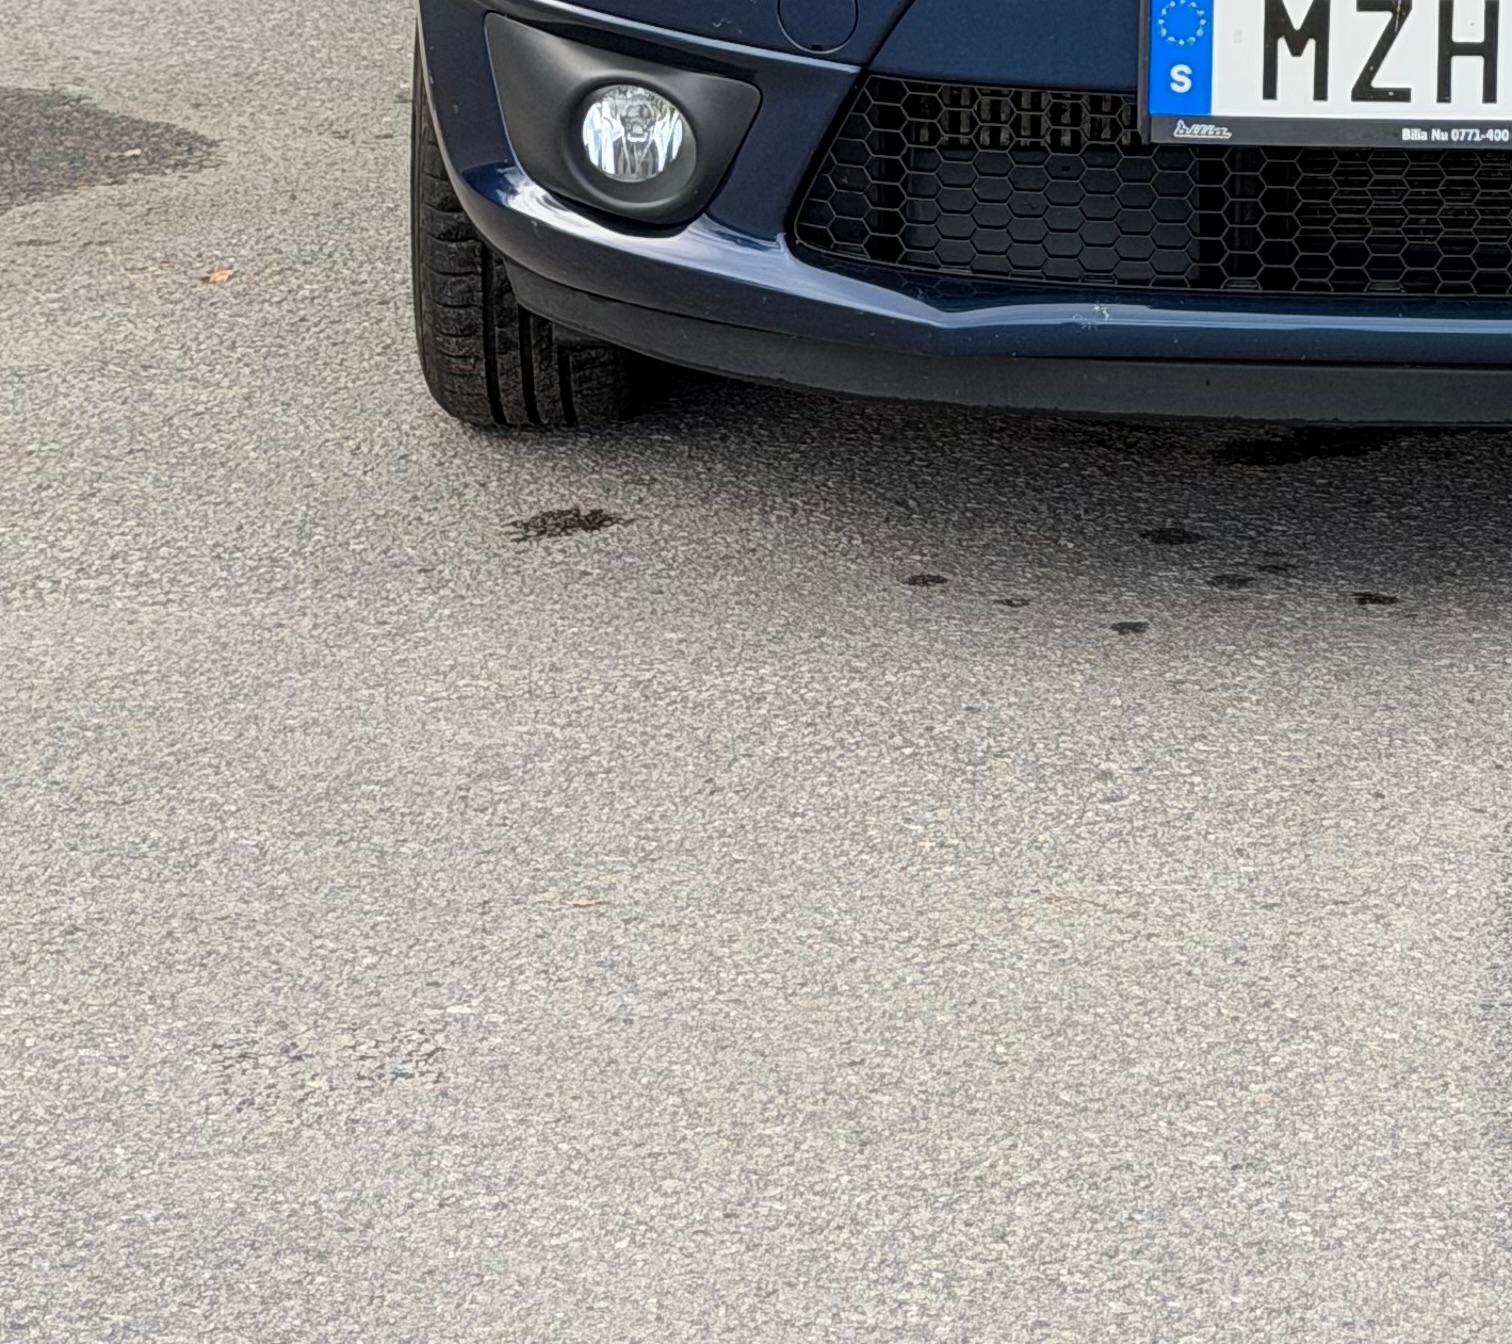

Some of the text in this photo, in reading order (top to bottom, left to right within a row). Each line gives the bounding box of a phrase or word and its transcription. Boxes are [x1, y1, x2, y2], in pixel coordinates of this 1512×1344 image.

[1169, 64, 1193, 93] S
[1401, 127, 1428, 141] Bilia
[1431, 128, 1449, 142] Nu
[1450, 128, 1510, 142] 0771-400
